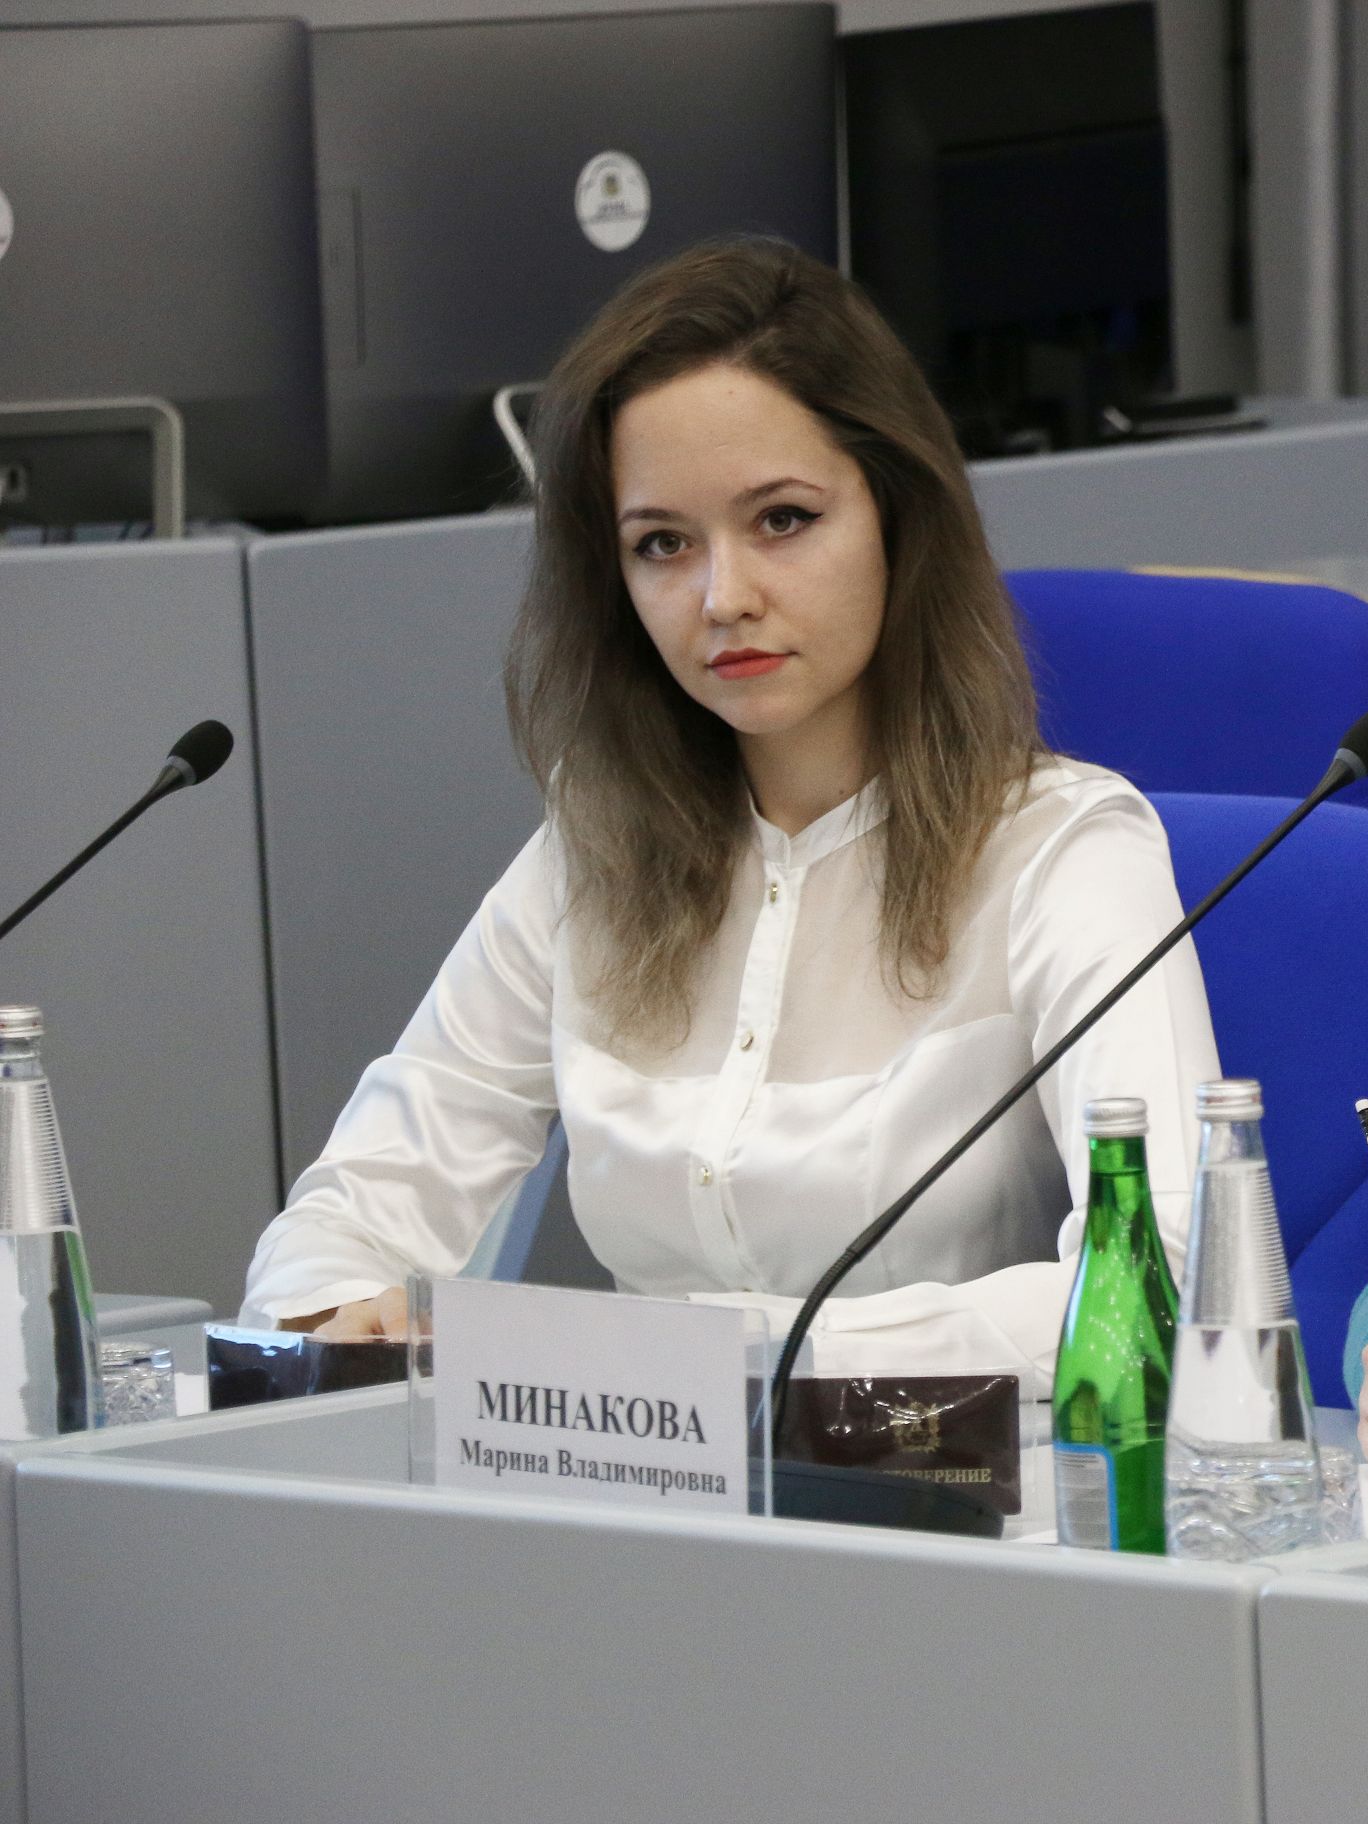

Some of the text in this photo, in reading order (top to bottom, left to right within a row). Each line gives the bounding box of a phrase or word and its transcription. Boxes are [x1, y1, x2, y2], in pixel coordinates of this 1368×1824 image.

[476, 1380, 708, 1445] МИНАКОВА
[459, 1437, 727, 1496] Марина Владимировна
